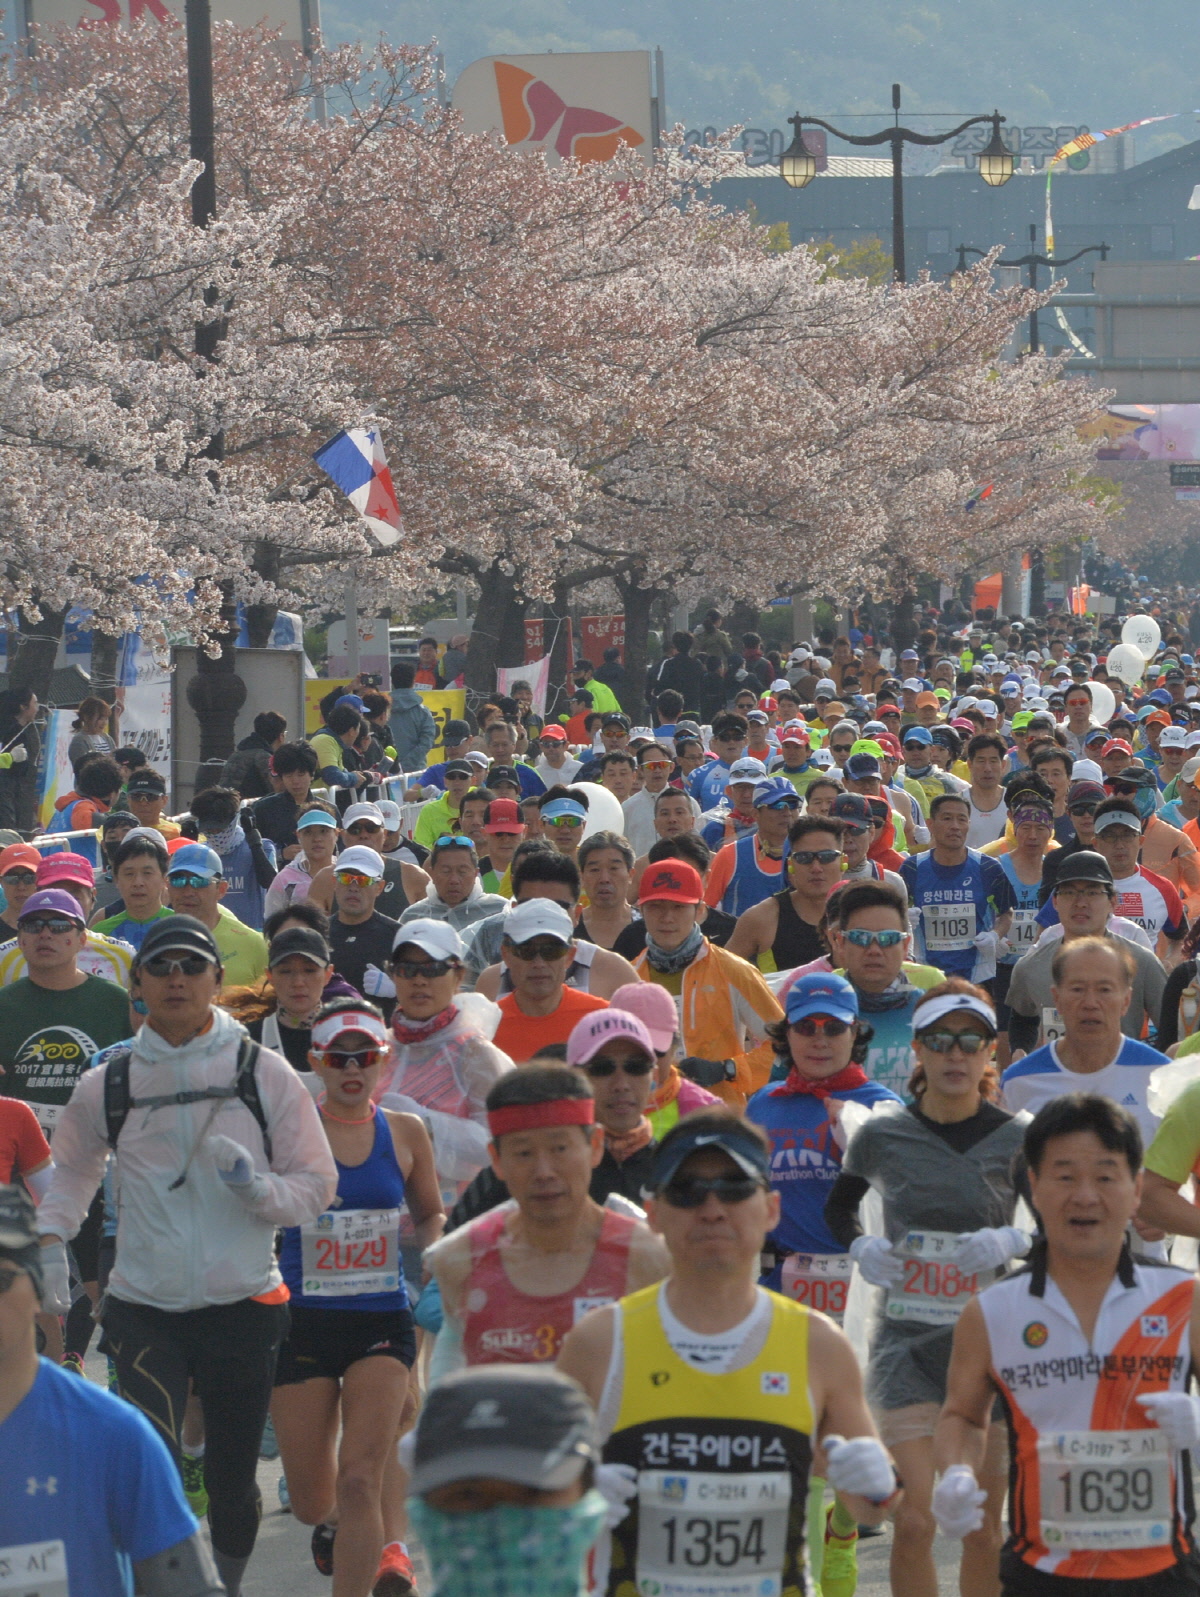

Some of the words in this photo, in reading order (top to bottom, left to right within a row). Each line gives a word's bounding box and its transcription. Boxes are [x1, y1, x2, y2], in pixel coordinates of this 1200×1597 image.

[923, 889, 974, 903] 양산마라톤
[931, 918, 969, 938] 1103
[15, 1063, 40, 1075] 2017
[315, 1235, 388, 1271] 2029
[642, 1432, 787, 1468] 건국에이스
[1058, 1466, 1154, 1514] 1639
[661, 1515, 767, 1568] 1354
